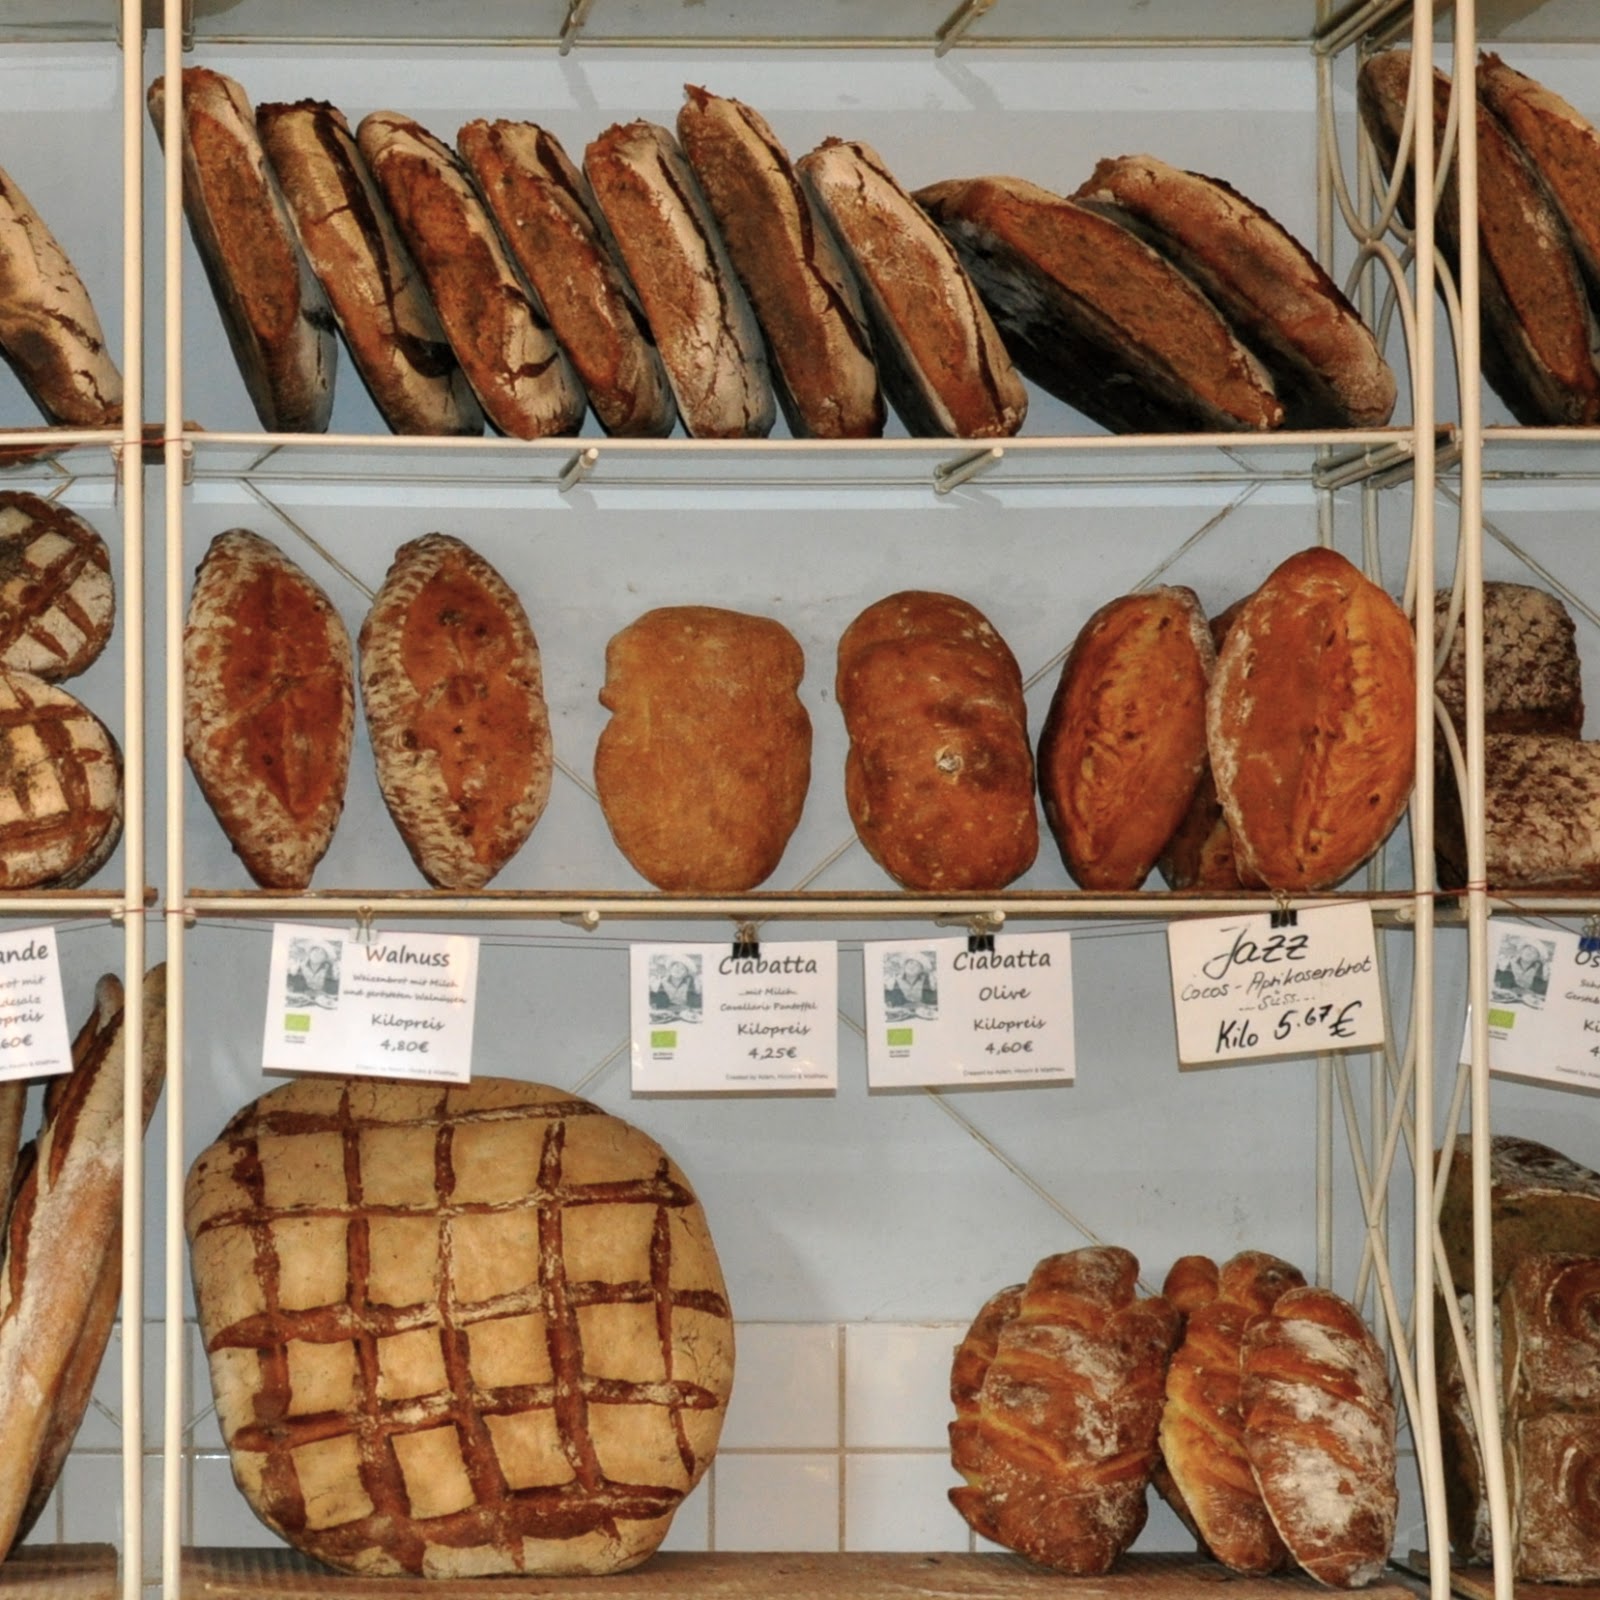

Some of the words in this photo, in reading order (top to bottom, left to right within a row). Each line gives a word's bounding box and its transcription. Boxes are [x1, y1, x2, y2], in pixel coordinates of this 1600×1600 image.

[366, 945, 450, 967] Walnuss
[1203, 923, 1309, 980] Jazz
[719, 956, 817, 975] Ciabatta
[953, 949, 1051, 971] Ciabatta
[410, 978, 427, 987] mit
[429, 979, 458, 988] Milch
[1181, 983, 1229, 1002] Cocos
[1246, 956, 1372, 998] Aprikosenbrot
[343, 988, 363, 996] und
[979, 985, 1031, 1001] Olive
[371, 1013, 445, 1032] Kilopreis
[974, 1016, 1046, 1033] Kilopreis
[738, 1023, 811, 1039] Kilopreis
[1216, 1018, 1259, 1053] Kilo
[0, 1034, 33, 1049] 60€
[380, 1040, 430, 1053] 4,80€
[985, 1040, 1033, 1055] 4,60€
[748, 1047, 798, 1060] 4,25€
